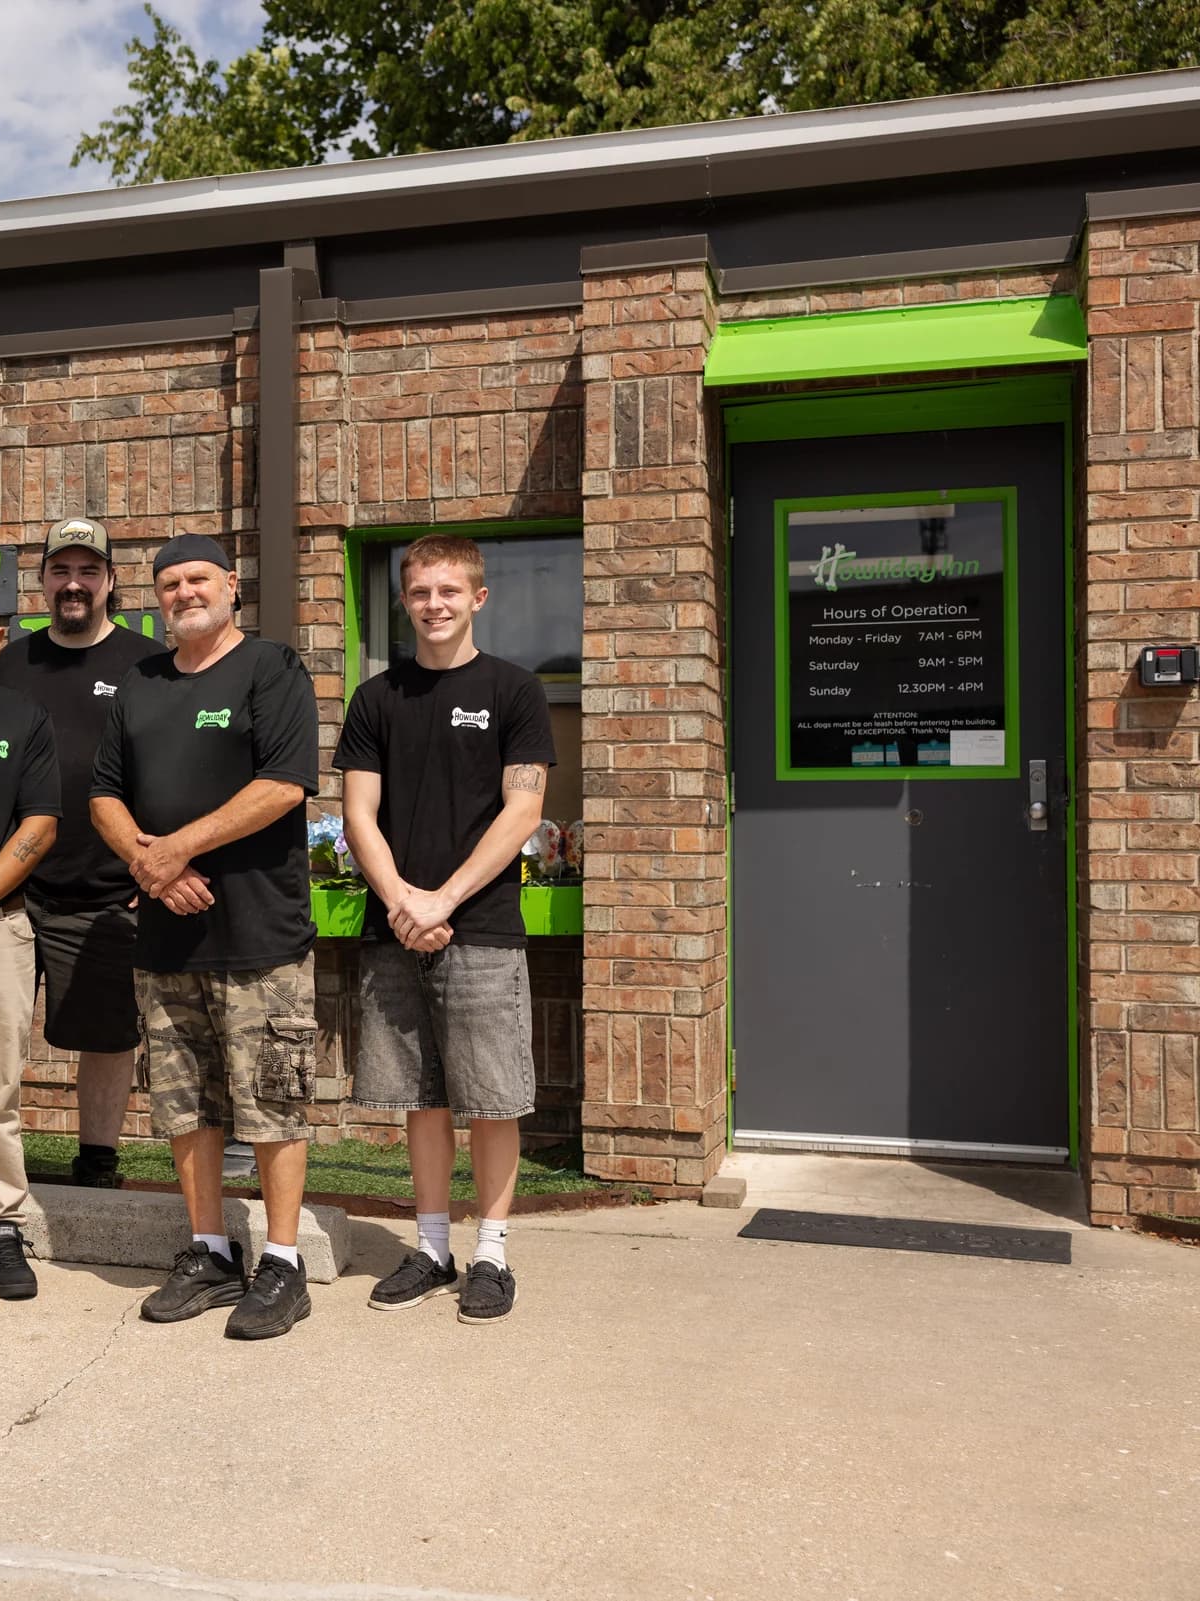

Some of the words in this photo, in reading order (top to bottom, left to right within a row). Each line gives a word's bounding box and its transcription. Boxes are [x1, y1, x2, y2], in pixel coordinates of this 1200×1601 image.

[941, 555, 980, 577] Inn
[823, 607, 867, 620] Hours
[871, 606, 887, 618] of
[891, 604, 968, 618] Operation
[809, 635, 854, 646] Monday
[865, 633, 902, 645] Friday
[918, 631, 945, 642] 7AM
[956, 630, 982, 640] 6PM
[809, 660, 860, 672] Saturday
[918, 657, 945, 668] 9AM
[957, 656, 983, 667] 5PM
[809, 686, 852, 697] Sunday
[897, 683, 945, 694] 12.30PM
[957, 682, 983, 692] 4PM
[454, 711, 487, 724] HOWLIDAY
[813, 722, 831, 730] dogs
[920, 720, 950, 728] entering
[858, 728, 907, 736] EXCEPTIONS.
[911, 727, 933, 735] Thank
